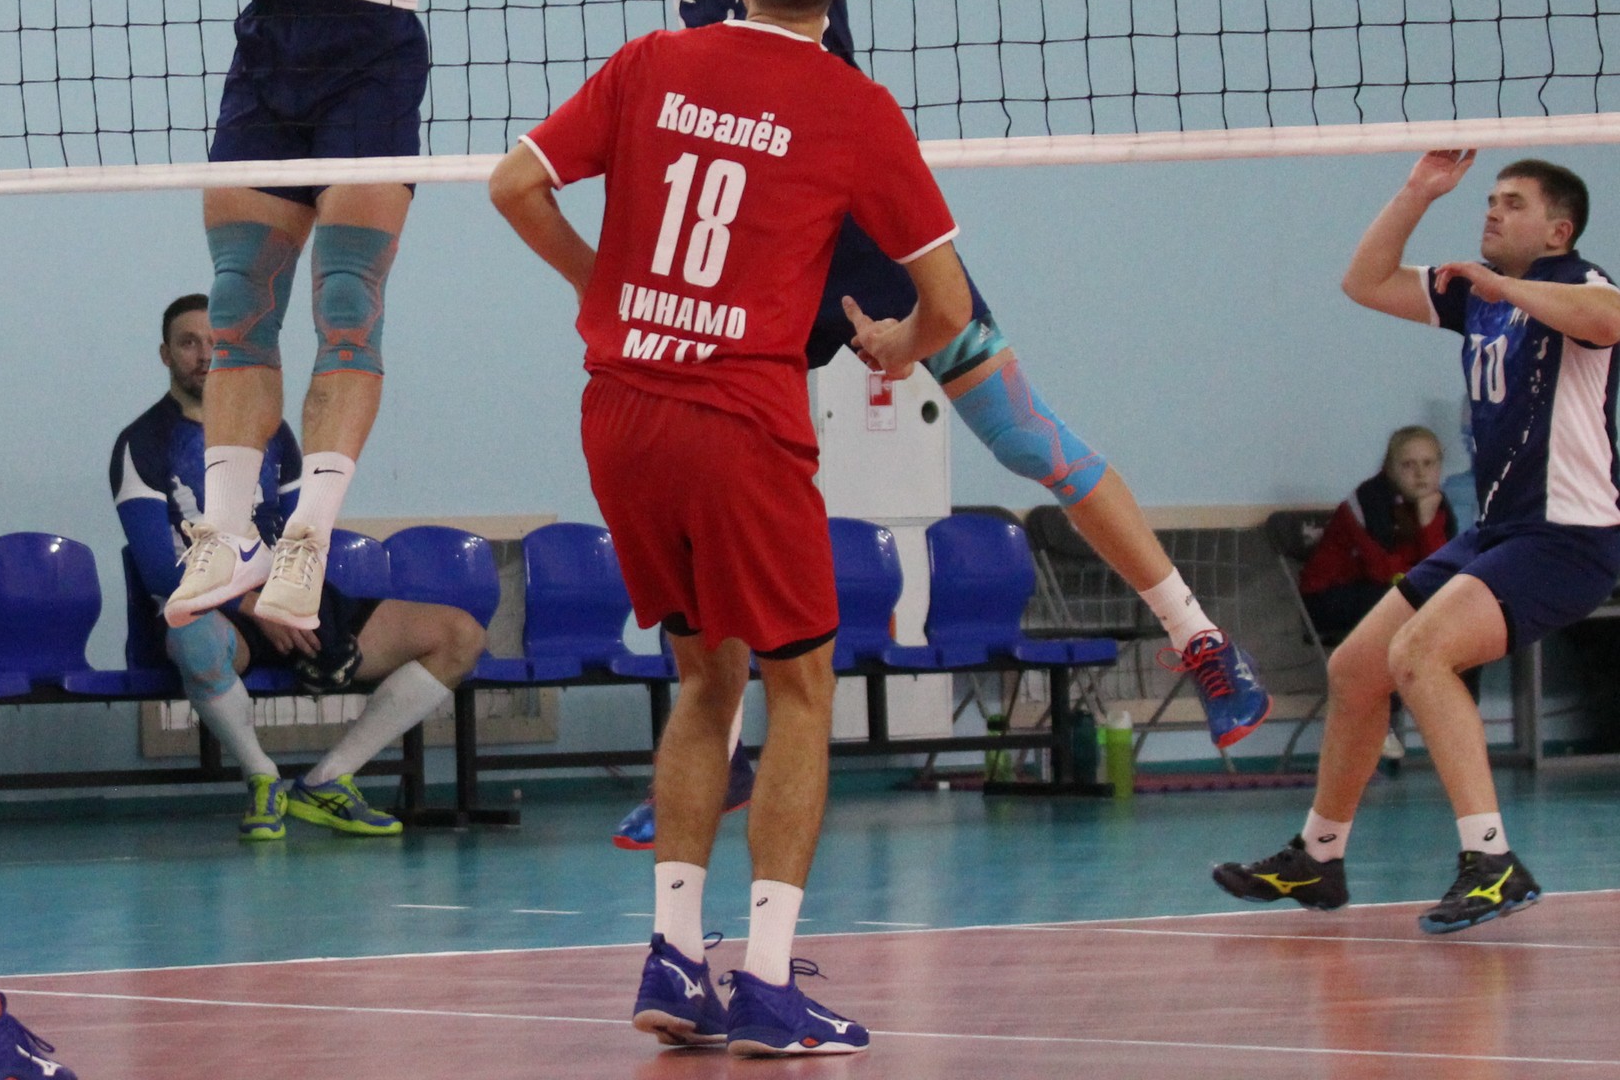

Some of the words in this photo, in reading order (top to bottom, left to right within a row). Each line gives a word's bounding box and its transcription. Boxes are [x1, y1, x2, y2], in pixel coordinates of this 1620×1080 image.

[657, 91, 792, 157] Ковалёв
[651, 152, 747, 288] 18
[618, 282, 746, 340] ДИНАМО
[622, 328, 718, 363] МГТУ
[1470, 333, 1508, 404] 10
